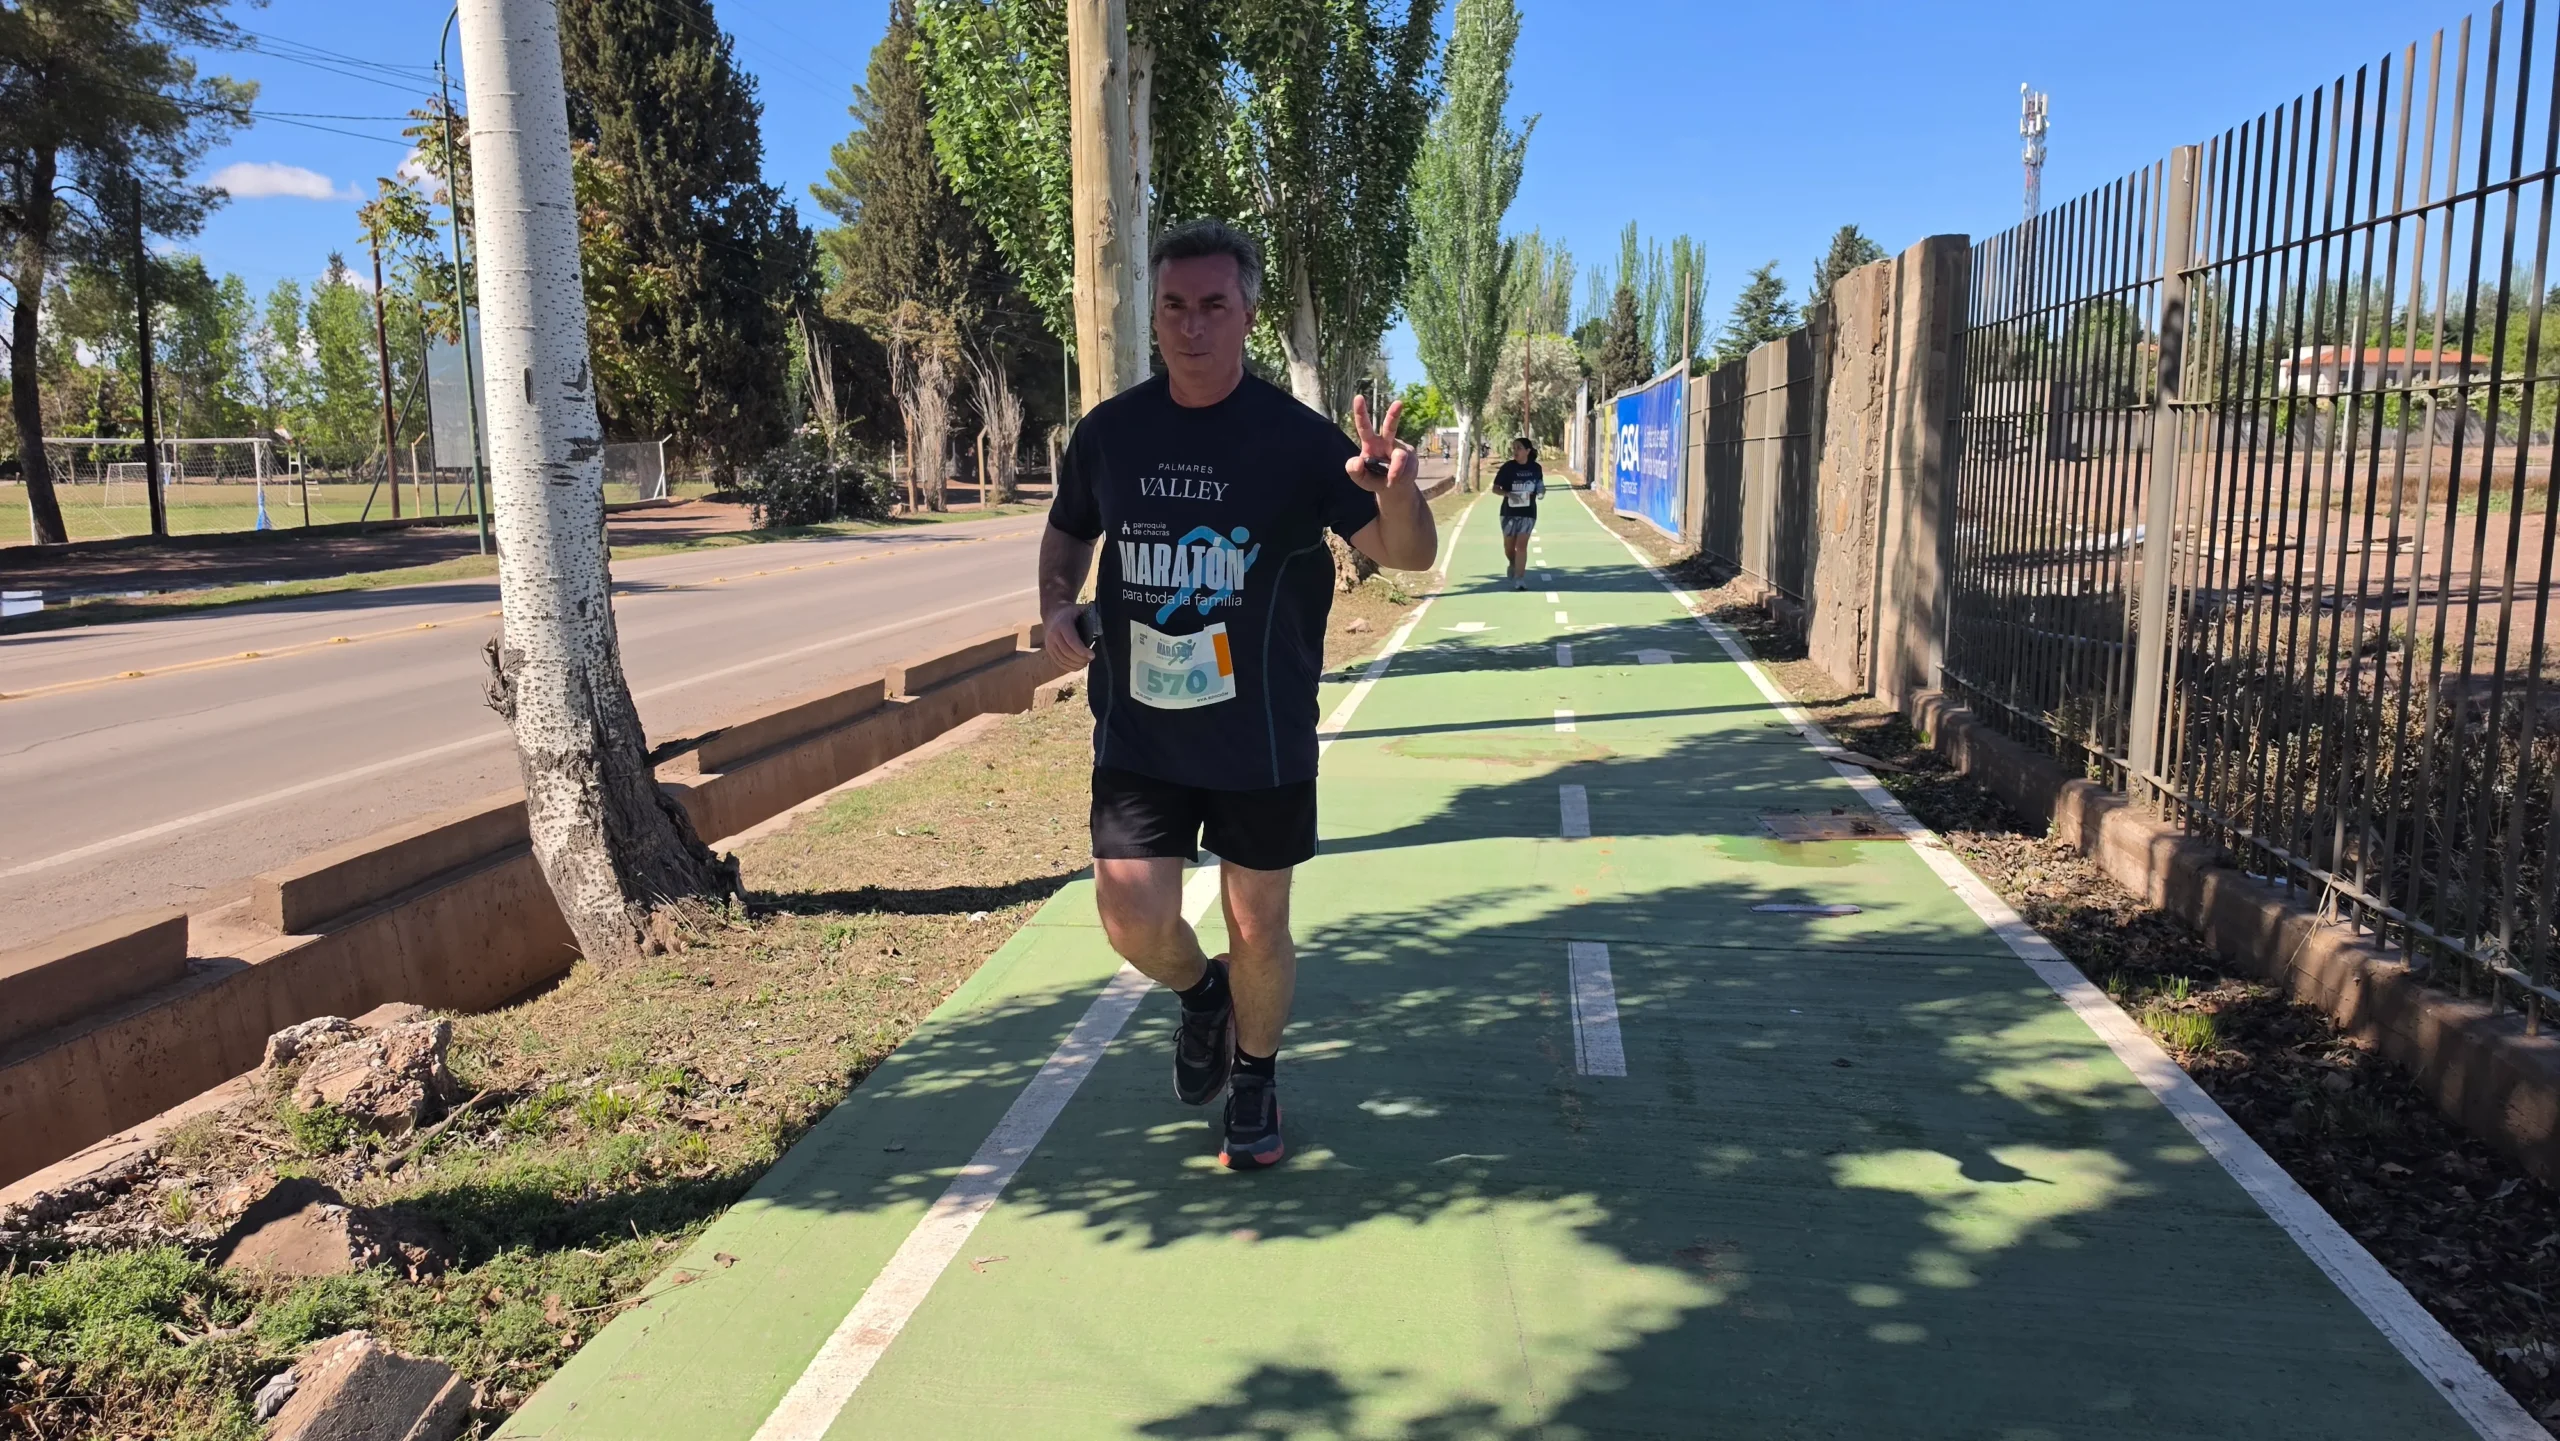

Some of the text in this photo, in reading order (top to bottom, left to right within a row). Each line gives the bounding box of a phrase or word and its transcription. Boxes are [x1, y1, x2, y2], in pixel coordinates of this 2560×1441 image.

[1620, 424, 1640, 472] GSA
[1158, 463, 1214, 474] PALMARES
[1139, 477, 1229, 501] VALLEY
[1133, 521, 1167, 530] parroquia
[1143, 529, 1170, 537] chacras
[1117, 536, 1244, 590] MARATÓN
[1122, 588, 1243, 607] para toda la familia
[1146, 668, 1208, 696] 570
